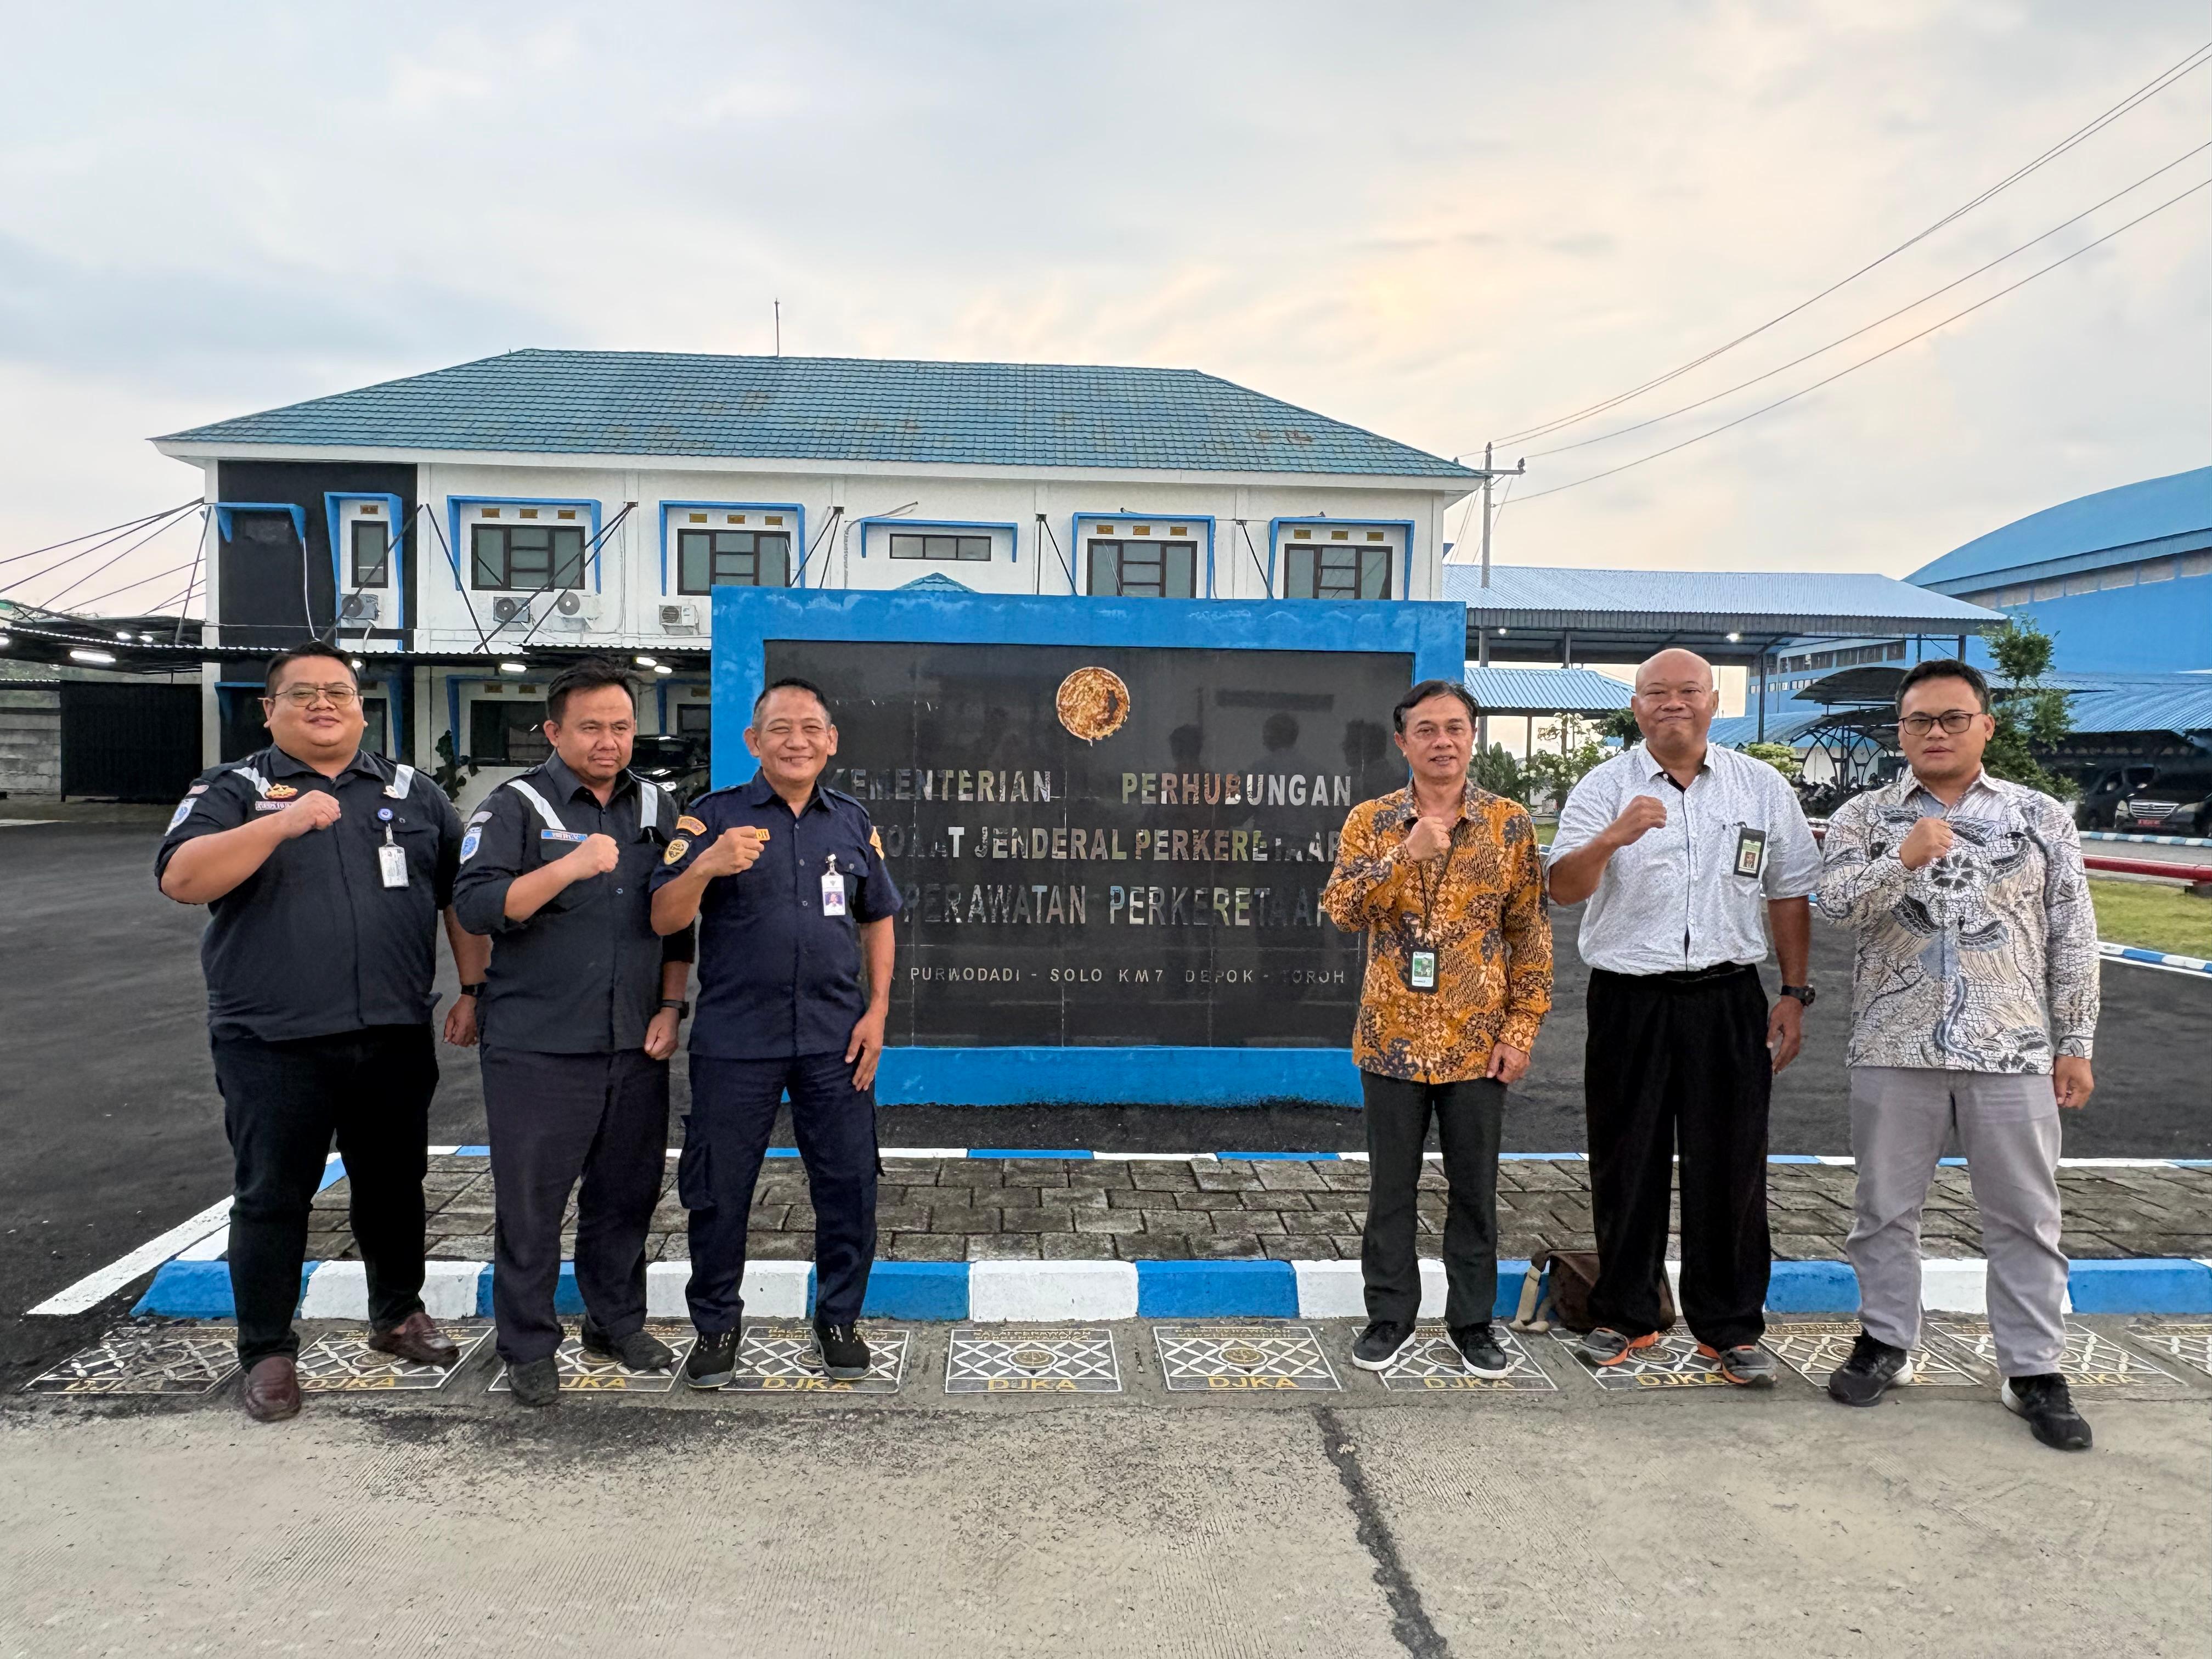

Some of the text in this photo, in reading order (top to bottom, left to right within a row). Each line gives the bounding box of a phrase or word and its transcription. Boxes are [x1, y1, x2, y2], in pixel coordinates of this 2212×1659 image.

[1122, 772, 1351, 806] PERHUBUNGAN
[974, 826, 1127, 860] JENDERAL
[911, 967, 1020, 982] PURWODADI
[1050, 968, 1103, 982] SOLO
[560, 1376, 628, 1389] JKA
[763, 1378, 854, 1390] DJKA
[989, 1379, 1078, 1390] DJKA
[1208, 1376, 1300, 1388] DJKA
[1424, 1378, 1515, 1389] DJKA
[1635, 1373, 1729, 1386] DJKA
